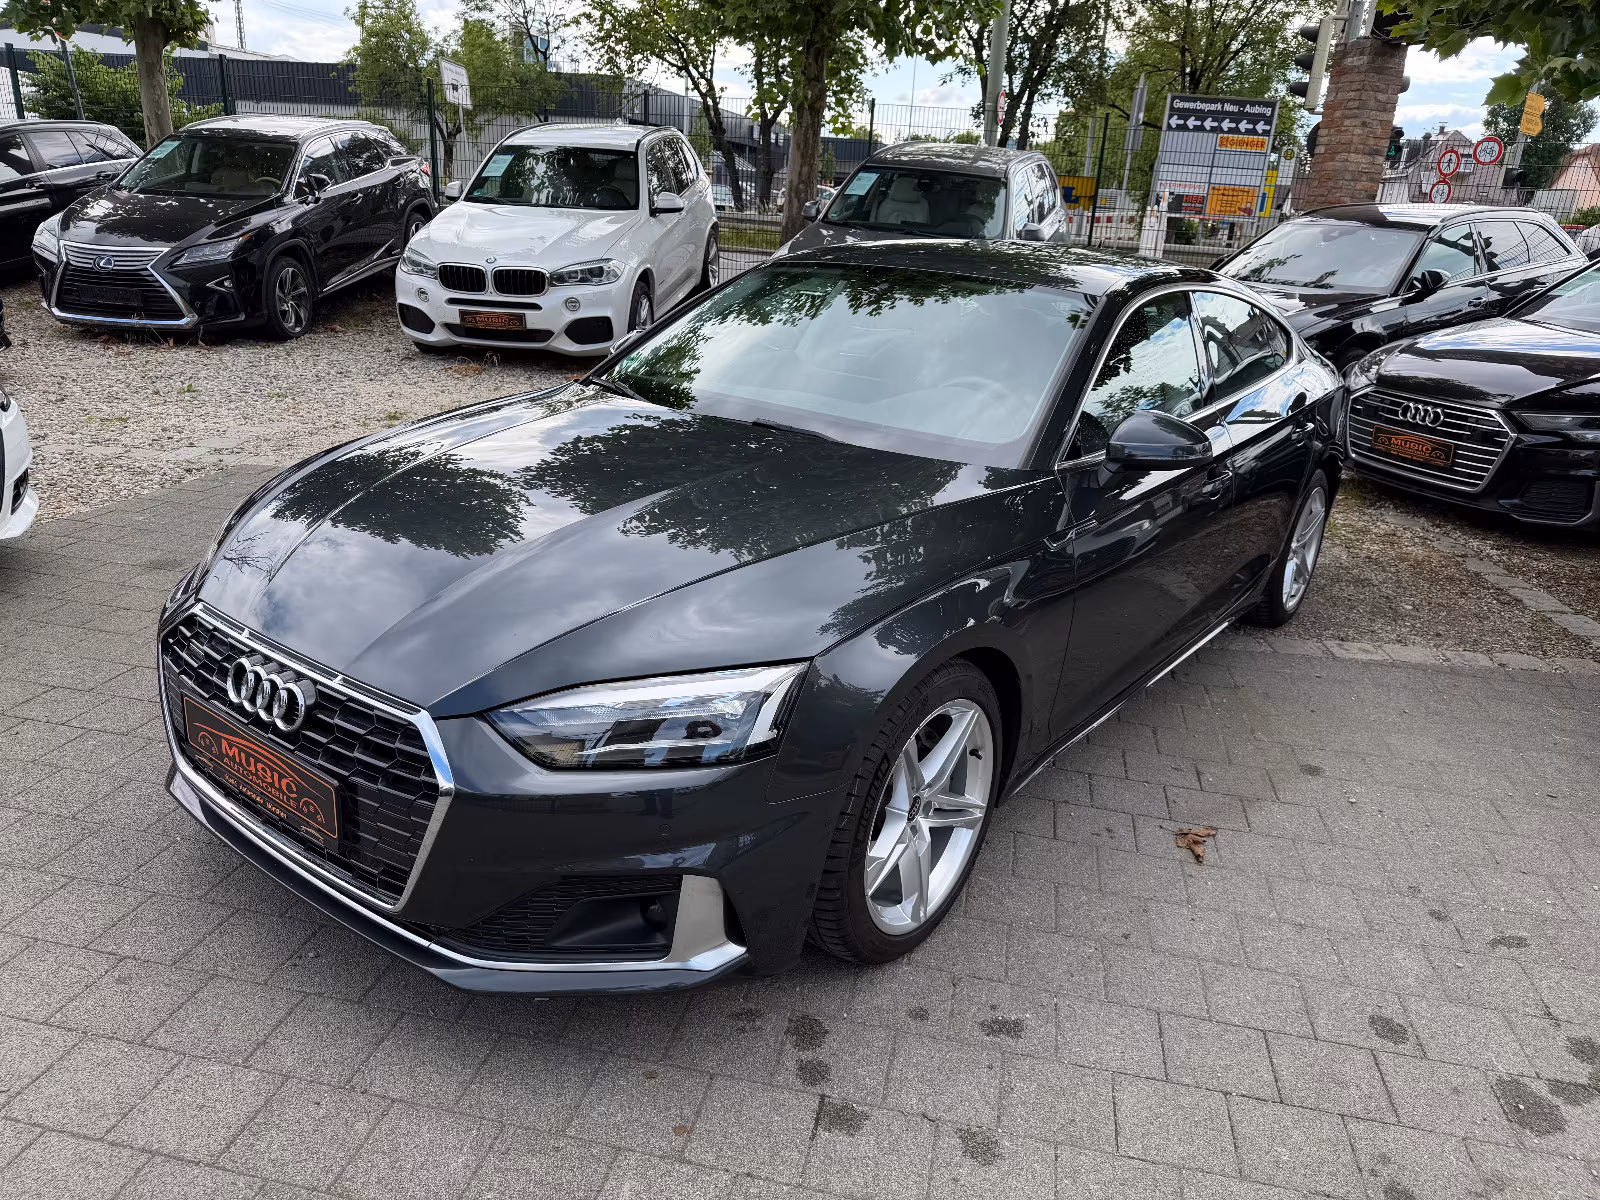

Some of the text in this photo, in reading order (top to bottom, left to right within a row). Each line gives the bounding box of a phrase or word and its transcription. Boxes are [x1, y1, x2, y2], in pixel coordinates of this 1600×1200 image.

[1173, 99, 1222, 112] Gewerbepark
[1223, 102, 1239, 112] Neu
[1244, 104, 1272, 116] Aubing
[1228, 138, 1266, 149] GIENGER
[1183, 195, 1204, 203] HIER
[223, 757, 298, 809] AUTOMOBILE
